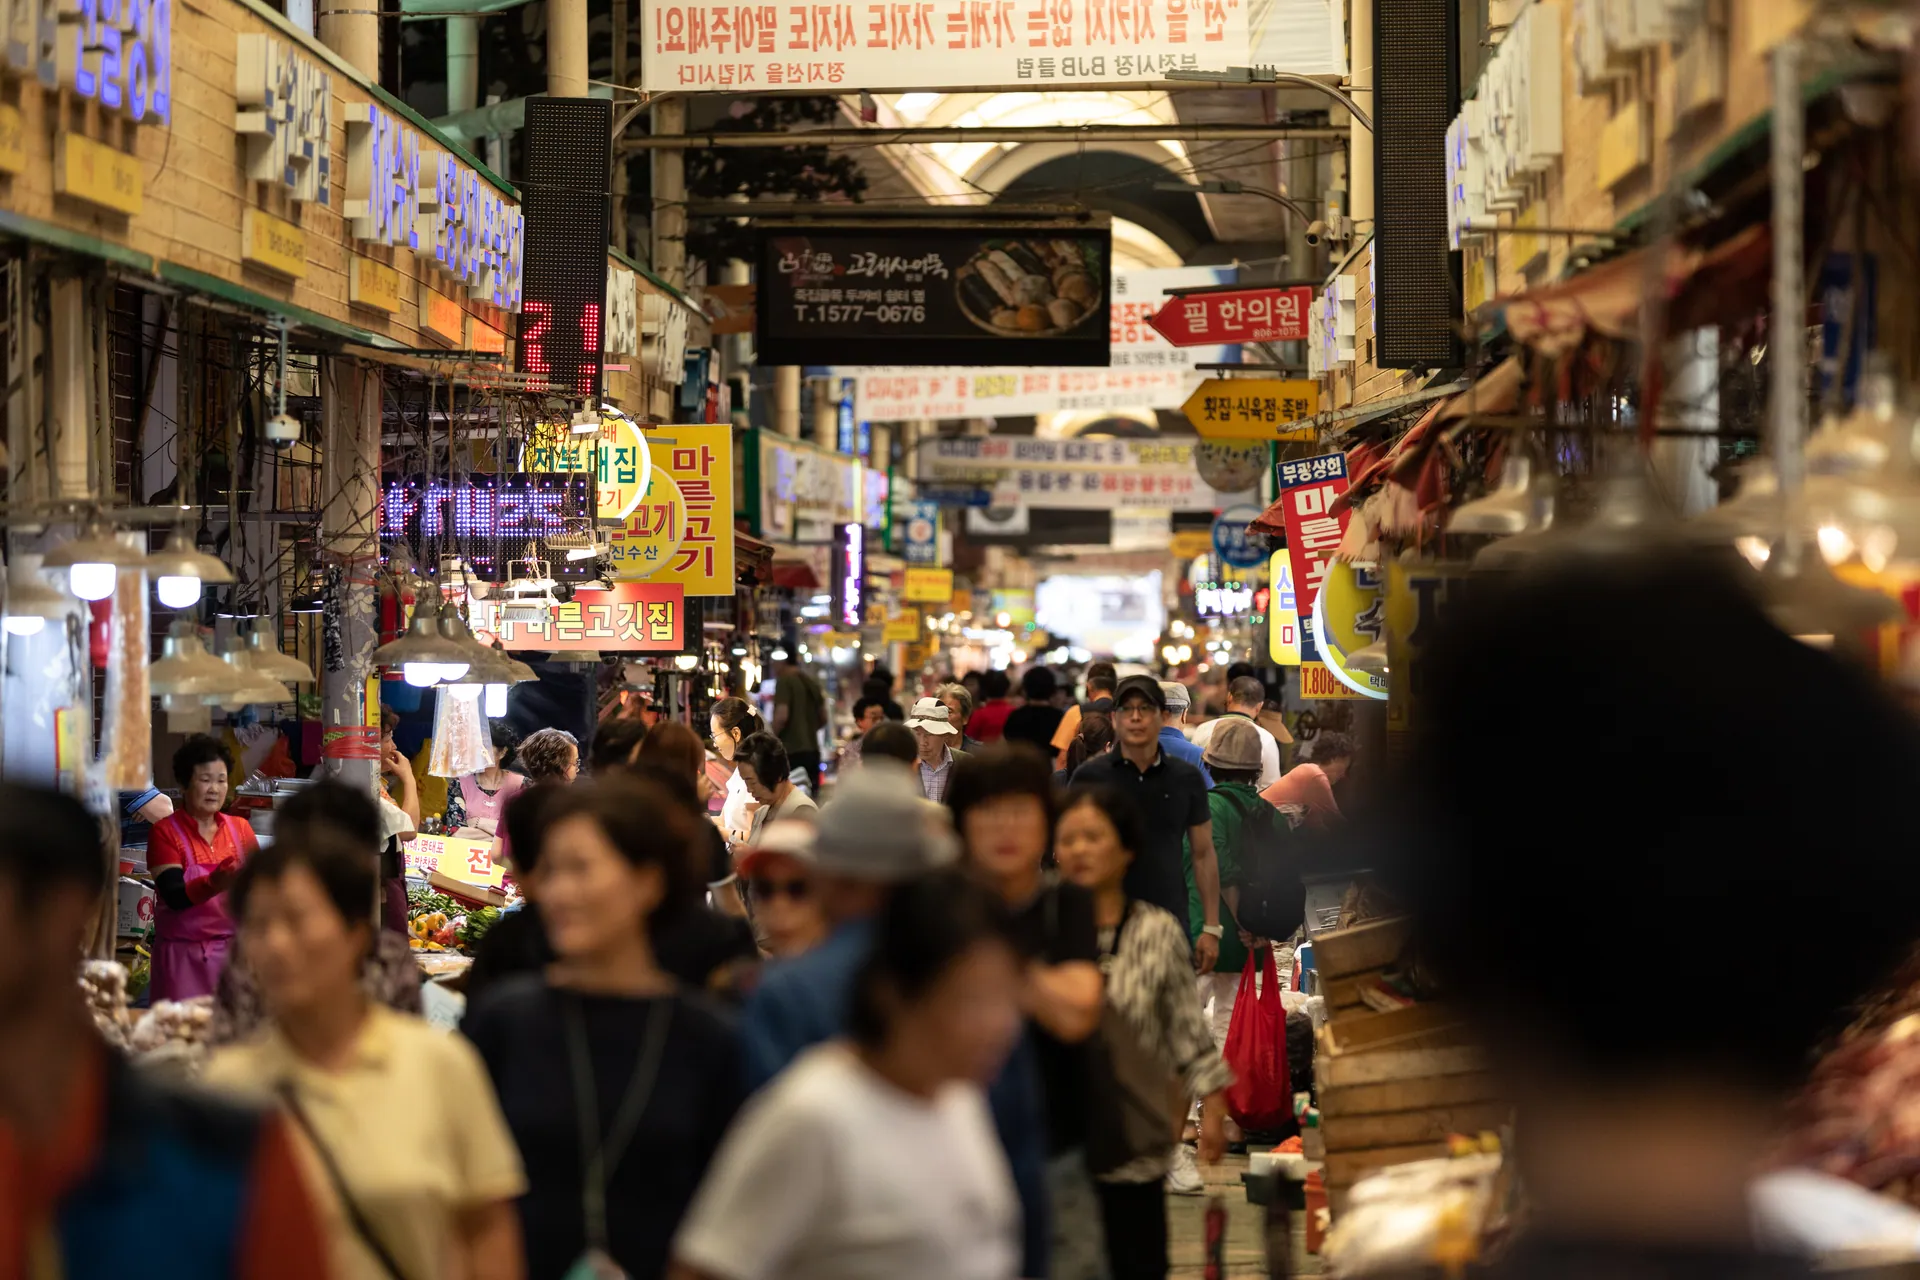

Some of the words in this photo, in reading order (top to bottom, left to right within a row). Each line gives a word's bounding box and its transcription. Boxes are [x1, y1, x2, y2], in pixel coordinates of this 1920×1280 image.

[846, 252, 949, 280] 고래사어묵
[794, 305, 926, 323] T.1577-0676
[1184, 301, 1209, 333] 필
[1218, 295, 1301, 331] 한의원
[673, 445, 716, 578] 마른고기
